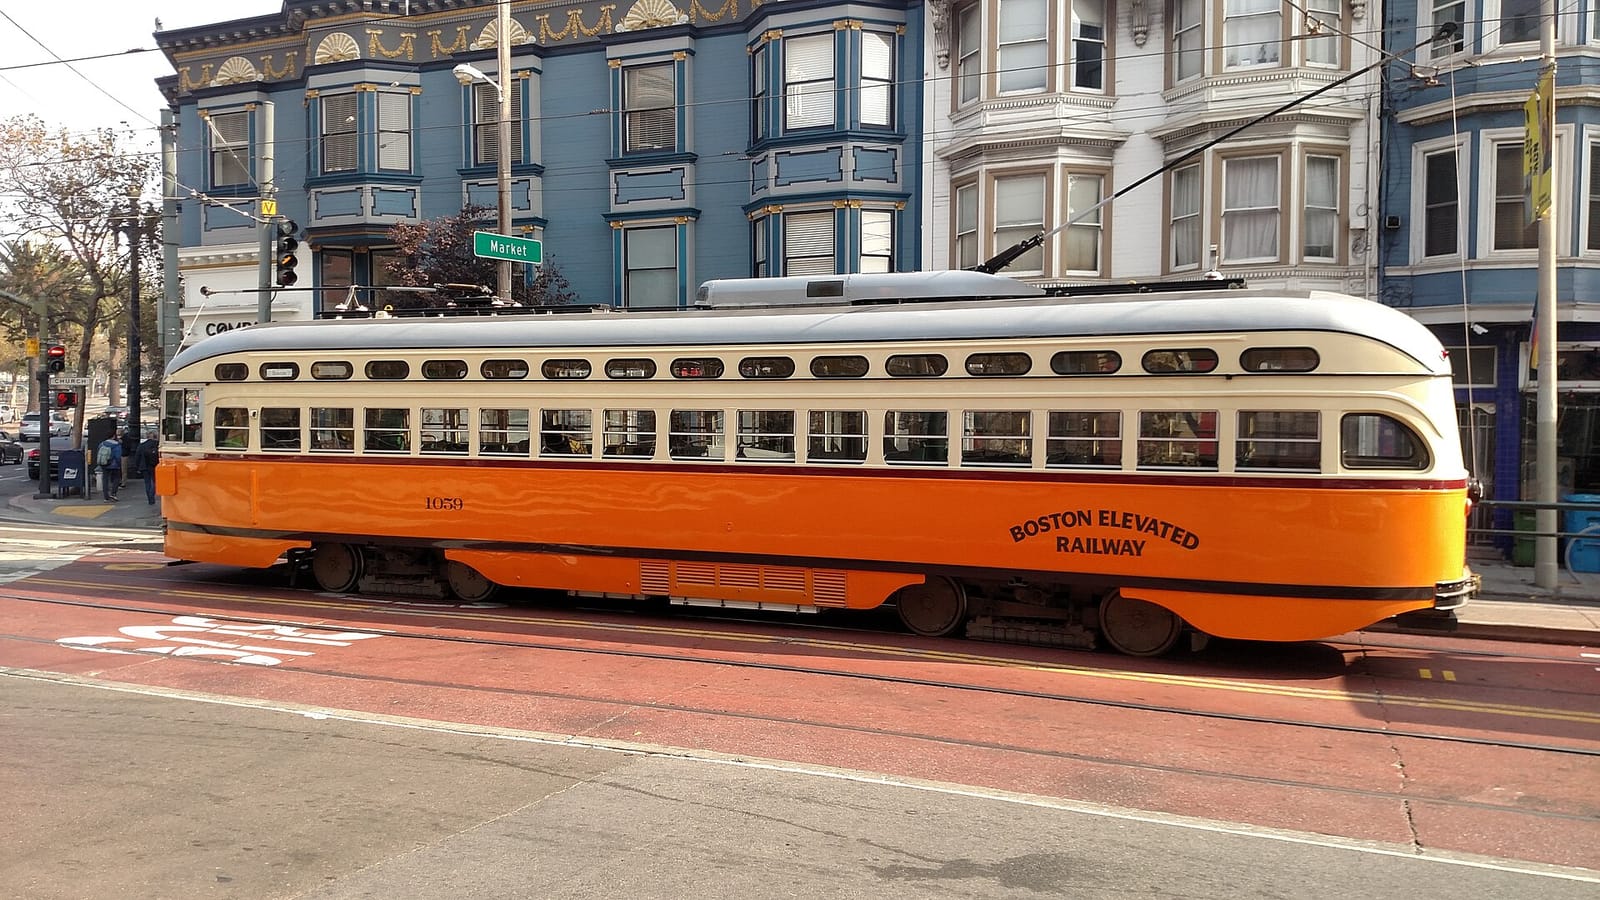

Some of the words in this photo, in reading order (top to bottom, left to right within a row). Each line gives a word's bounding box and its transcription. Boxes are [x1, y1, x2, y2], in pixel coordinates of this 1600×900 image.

[490, 239, 527, 257] Market
[425, 496, 464, 511] 1059
[1009, 509, 1092, 543] BOSTON
[1098, 509, 1200, 551] ELEVATED
[1056, 536, 1146, 557] RAILWAY
